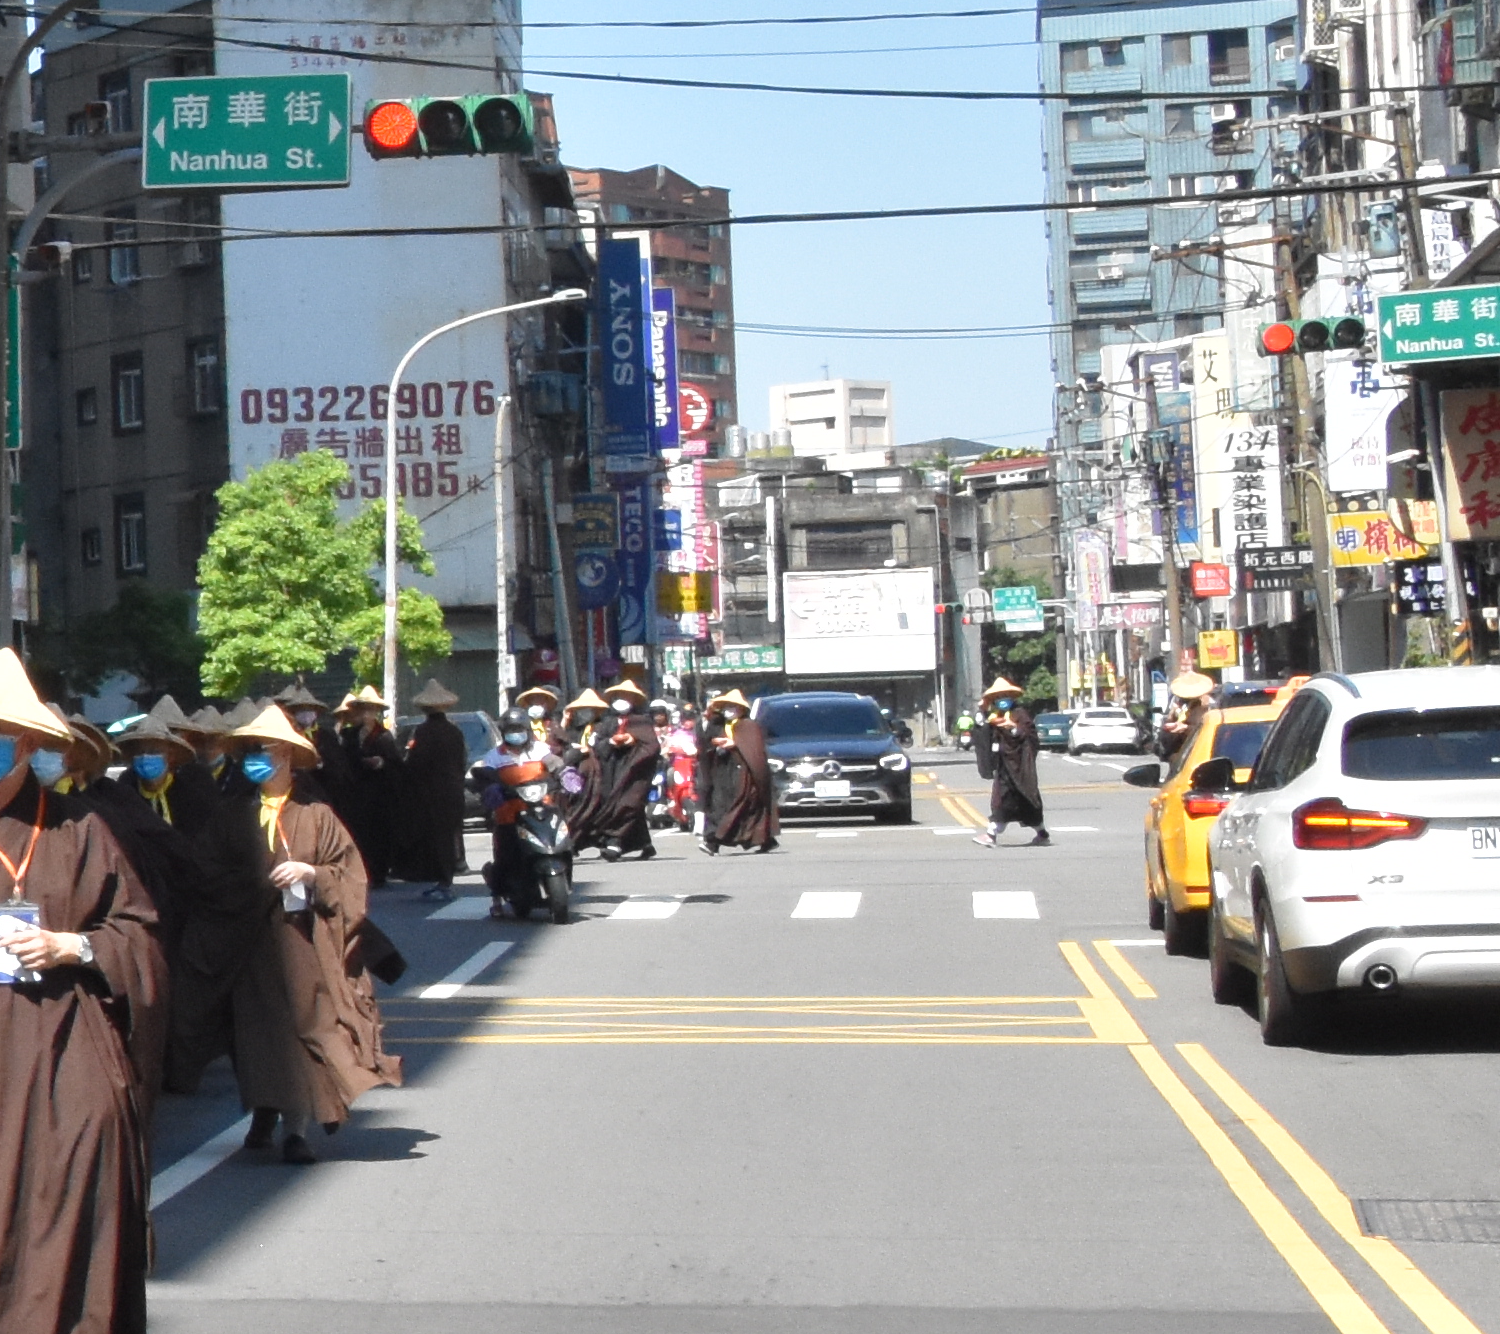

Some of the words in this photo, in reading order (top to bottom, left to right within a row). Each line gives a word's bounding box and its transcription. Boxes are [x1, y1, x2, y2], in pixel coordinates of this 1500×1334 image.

[171, 90, 323, 129] 南華街
[170, 148, 268, 172] Nanhua
[286, 147, 323, 169] St.
[1395, 296, 1498, 327] 南華街
[609, 278, 634, 386] SONY
[1396, 337, 1463, 354] Nanhua
[1474, 333, 1499, 348] St.
[240, 380, 495, 424] 0932269076
[278, 423, 463, 460] 廣告牆出租
[624, 485, 644, 554] TECO
[1367, 874, 1405, 885] X3
